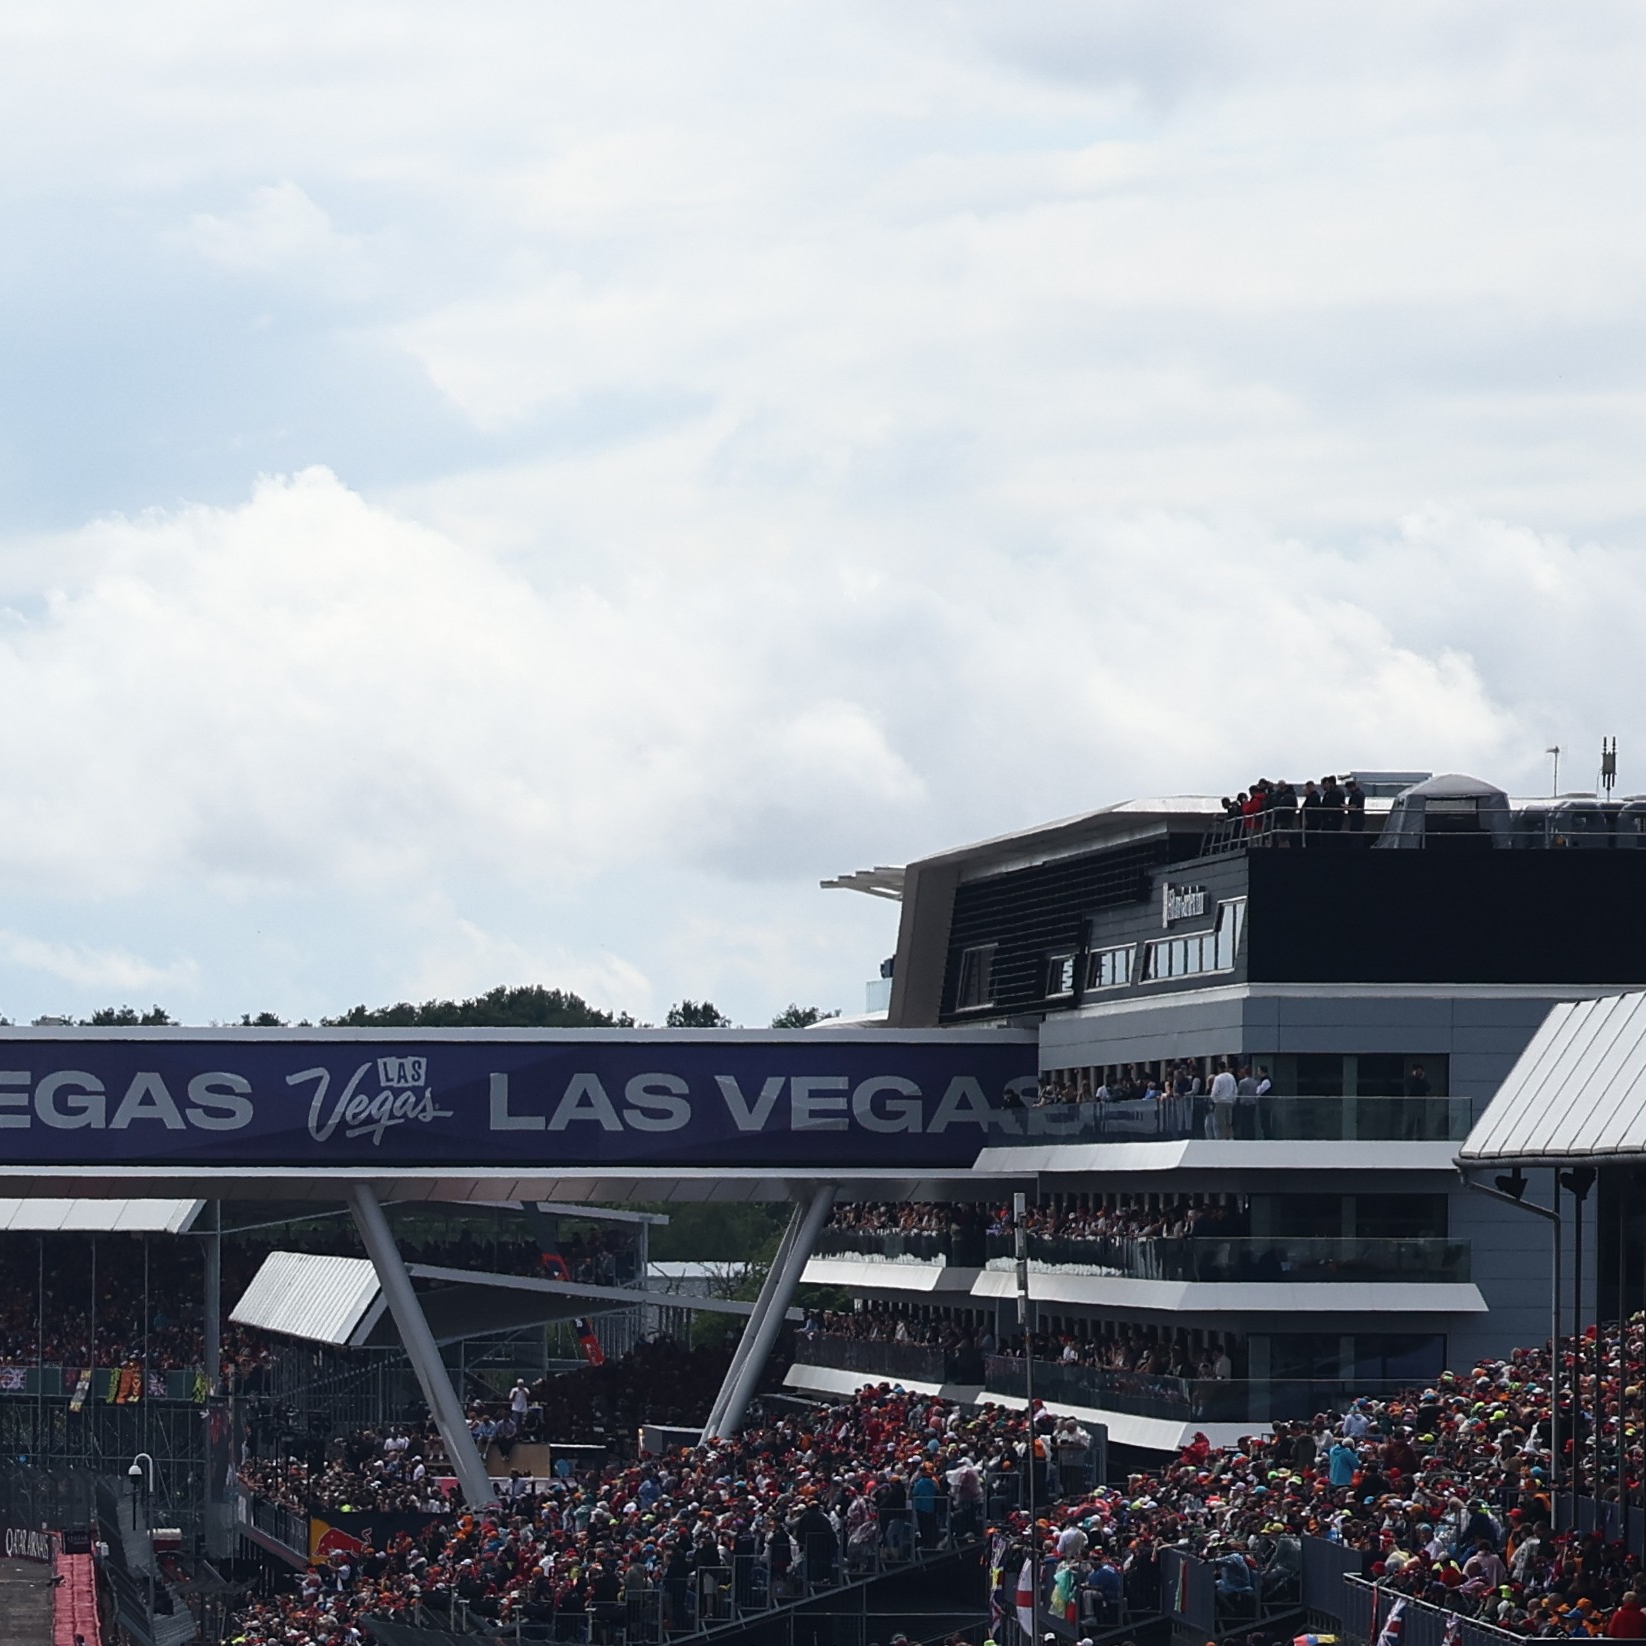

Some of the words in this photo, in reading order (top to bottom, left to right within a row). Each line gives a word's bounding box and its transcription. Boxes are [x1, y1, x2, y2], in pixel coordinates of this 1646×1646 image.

[380, 1057, 425, 1086] LAS
[286, 1062, 454, 1146] Vegas
[489, 1072, 692, 1132] LAS
